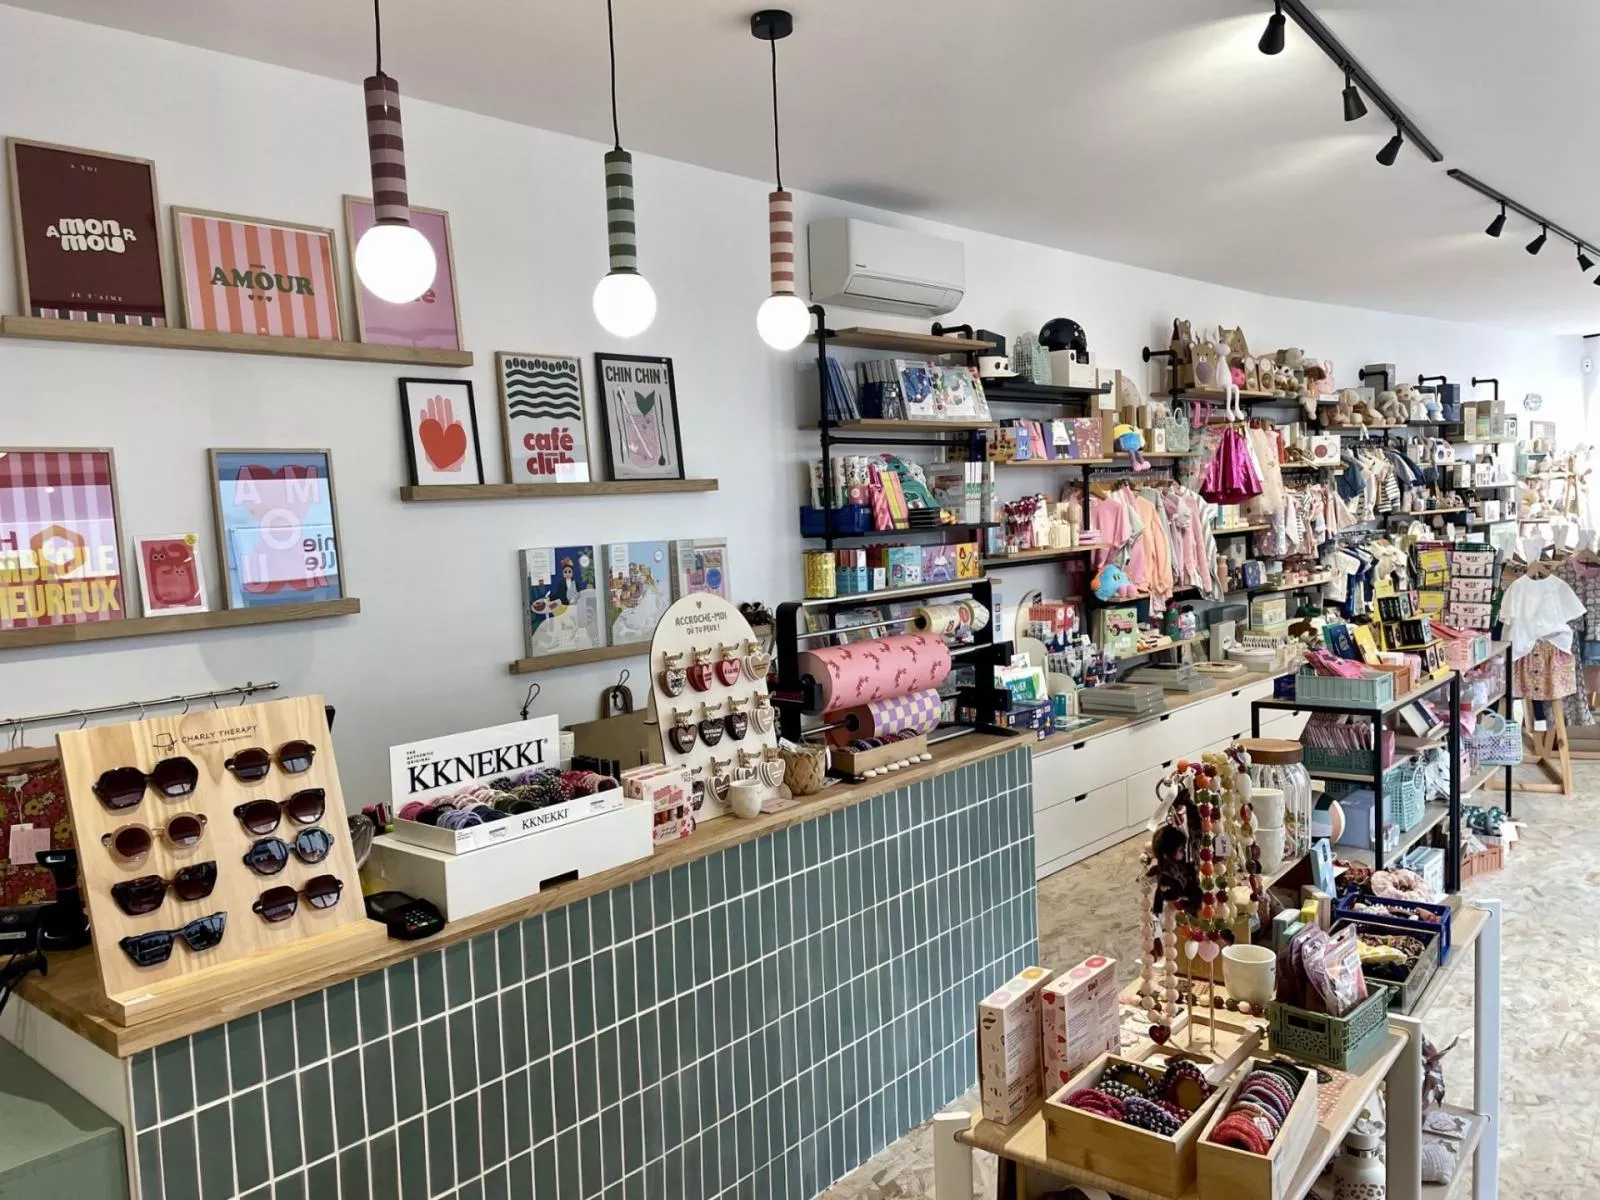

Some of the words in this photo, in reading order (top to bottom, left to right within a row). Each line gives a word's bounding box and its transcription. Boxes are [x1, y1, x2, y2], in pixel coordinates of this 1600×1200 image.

[211, 266, 314, 296] AMOUR
[605, 366, 632, 383] CHIN
[635, 367, 661, 384] CHIN
[523, 427, 574, 451] café
[675, 612, 727, 626] ACCROCHE-MOI
[181, 732, 216, 743] CHARLY
[219, 725, 257, 737] THERAPY
[407, 738, 545, 795] KKNEKKI
[522, 808, 569, 829] KKNEKKI
